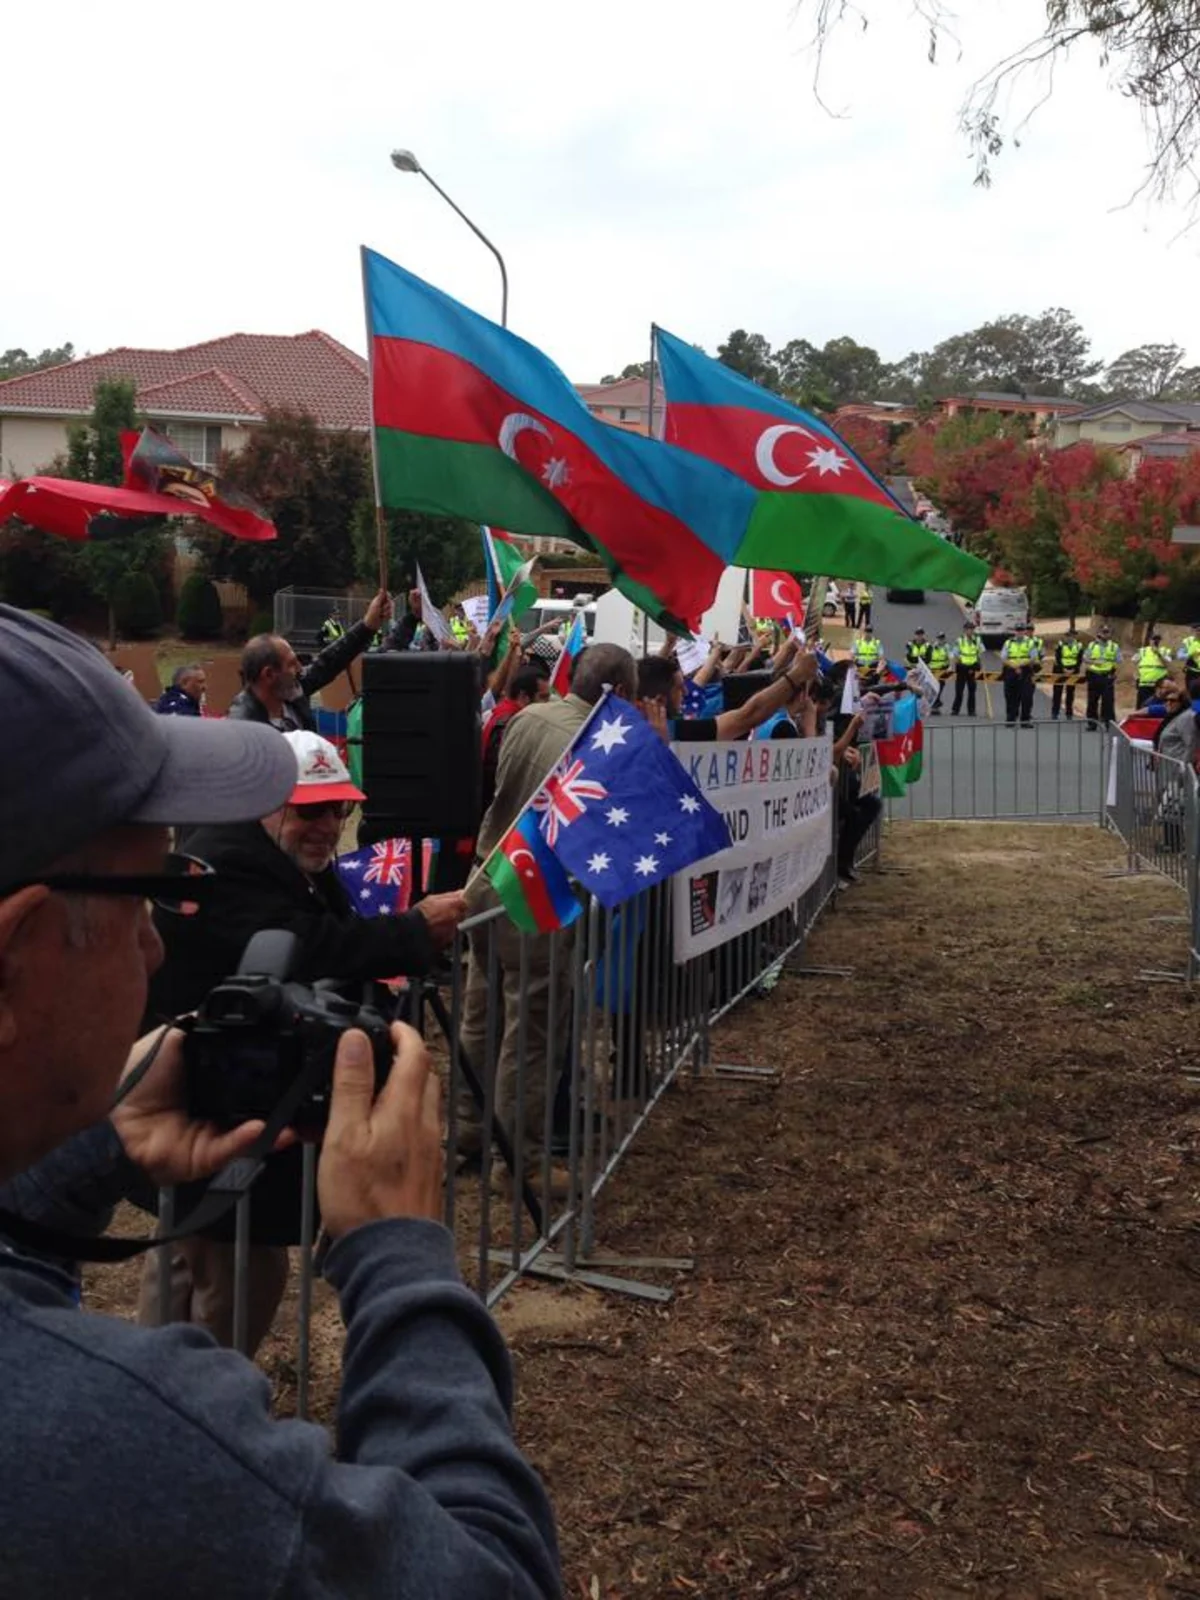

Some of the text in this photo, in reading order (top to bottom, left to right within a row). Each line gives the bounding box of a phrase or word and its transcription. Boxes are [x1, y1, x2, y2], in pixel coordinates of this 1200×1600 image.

[690, 746, 804, 789] KARABAKH
[721, 808, 749, 842] ND
[763, 797, 788, 830] THE
